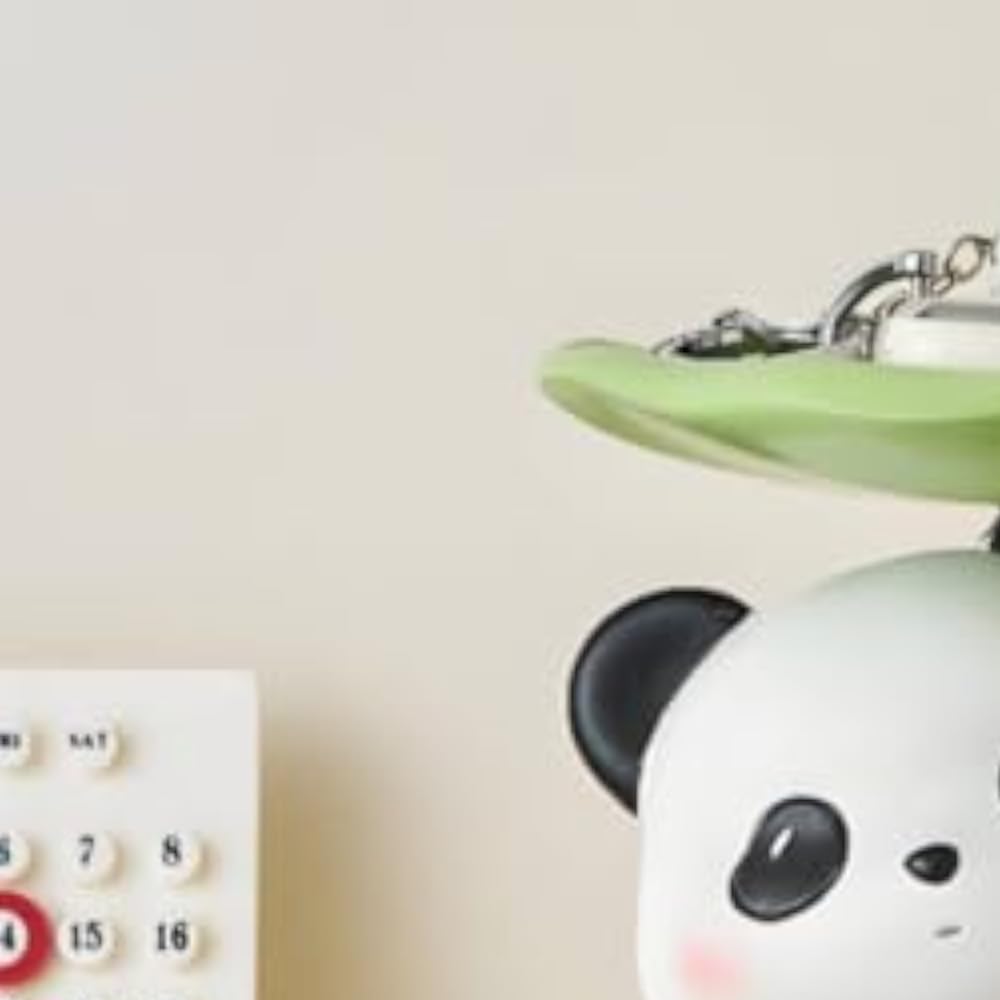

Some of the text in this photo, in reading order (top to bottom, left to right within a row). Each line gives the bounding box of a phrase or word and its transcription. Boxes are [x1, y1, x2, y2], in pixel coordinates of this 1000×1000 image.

[78, 834, 95, 865] 7
[162, 835, 182, 865] 8
[70, 920, 103, 951] 15
[156, 921, 189, 951] 16
